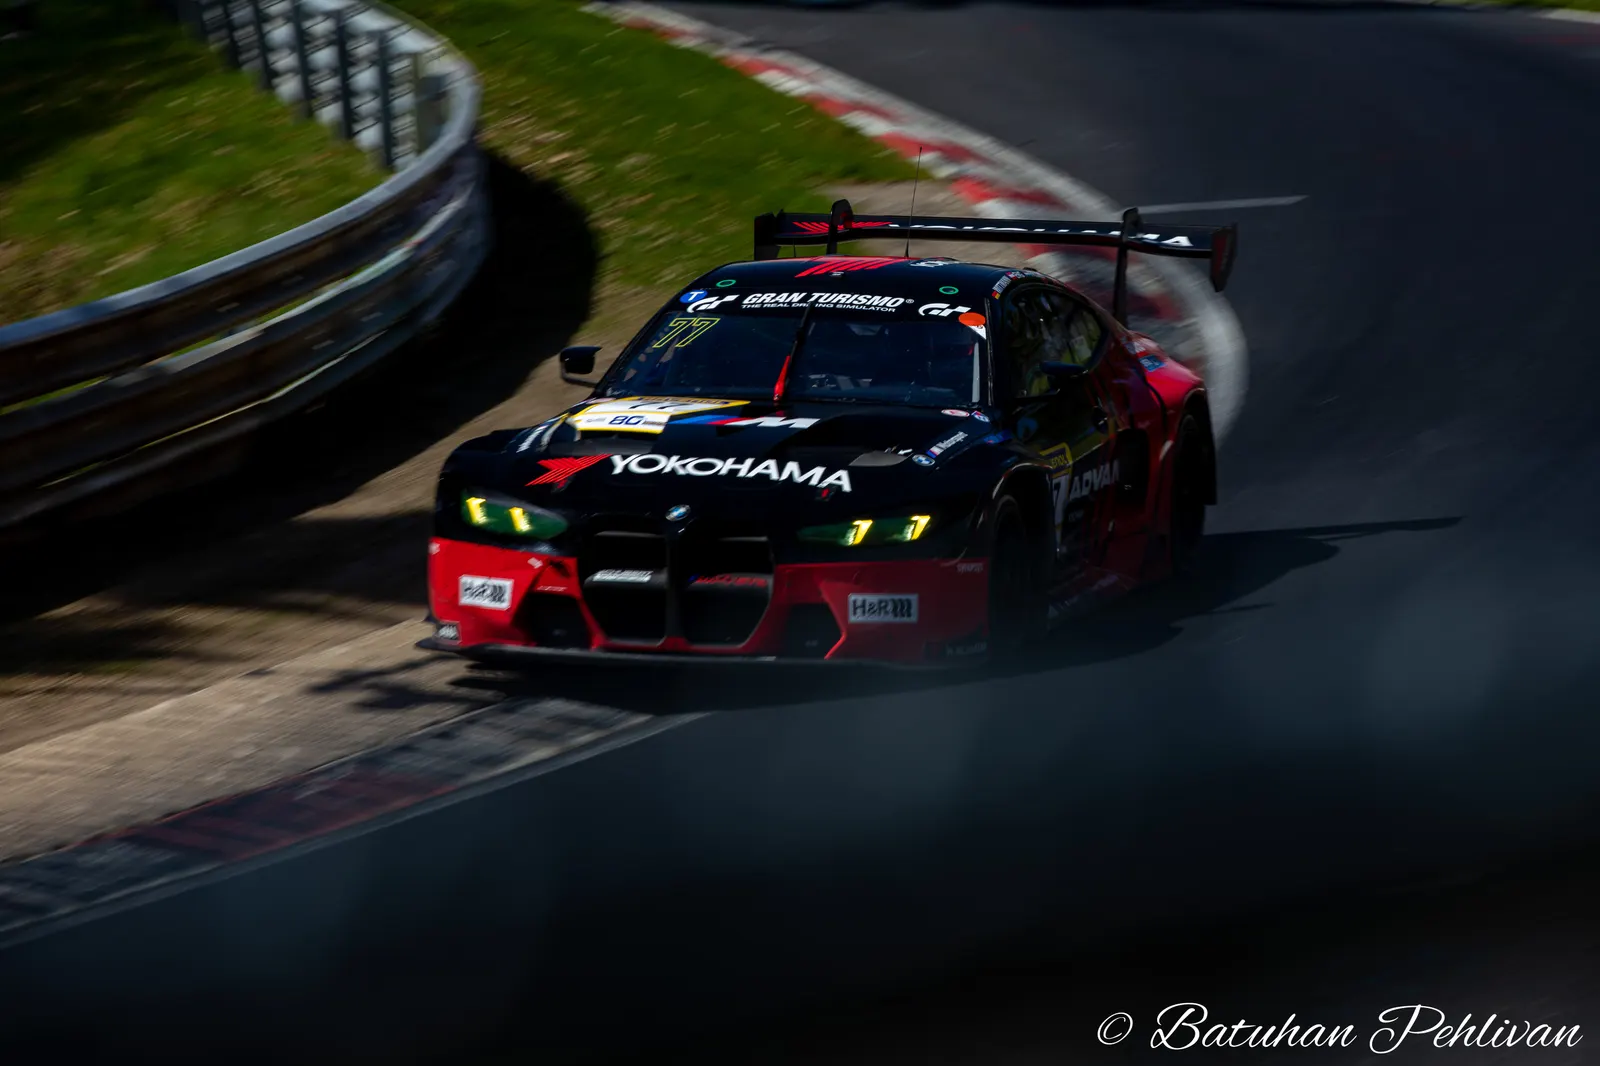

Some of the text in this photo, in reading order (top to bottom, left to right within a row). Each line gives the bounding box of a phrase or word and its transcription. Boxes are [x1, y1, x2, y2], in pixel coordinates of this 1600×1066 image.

[742, 292, 807, 304] GRAN
[836, 303, 896, 312] SIMULATOR
[652, 317, 721, 348] 77
[610, 453, 853, 493] YOKOHAMA
